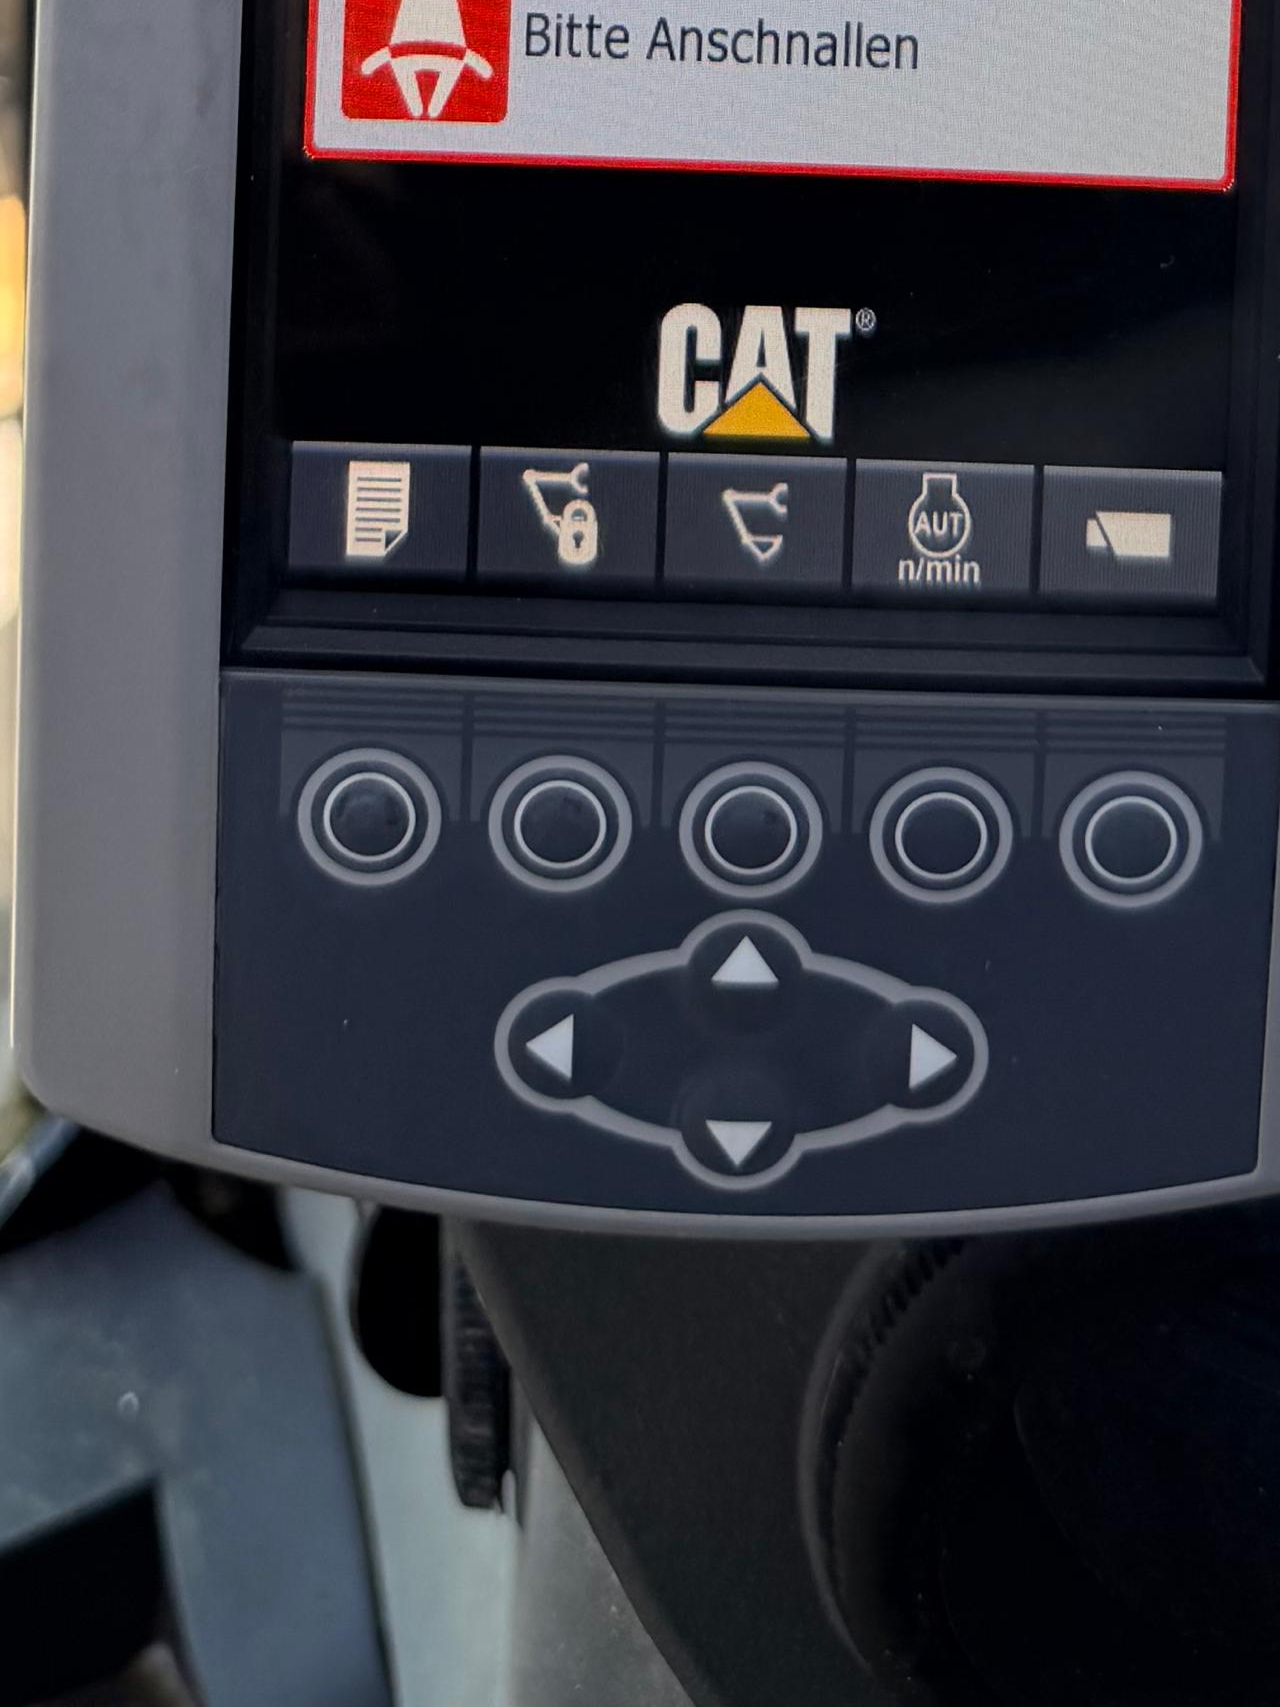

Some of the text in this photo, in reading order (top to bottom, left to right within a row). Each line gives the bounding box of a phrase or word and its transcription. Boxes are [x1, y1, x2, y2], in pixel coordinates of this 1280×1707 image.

[524, 12, 920, 69] Bitte Anschnallen
[913, 511, 963, 538] AUT
[898, 553, 980, 583] n/min
